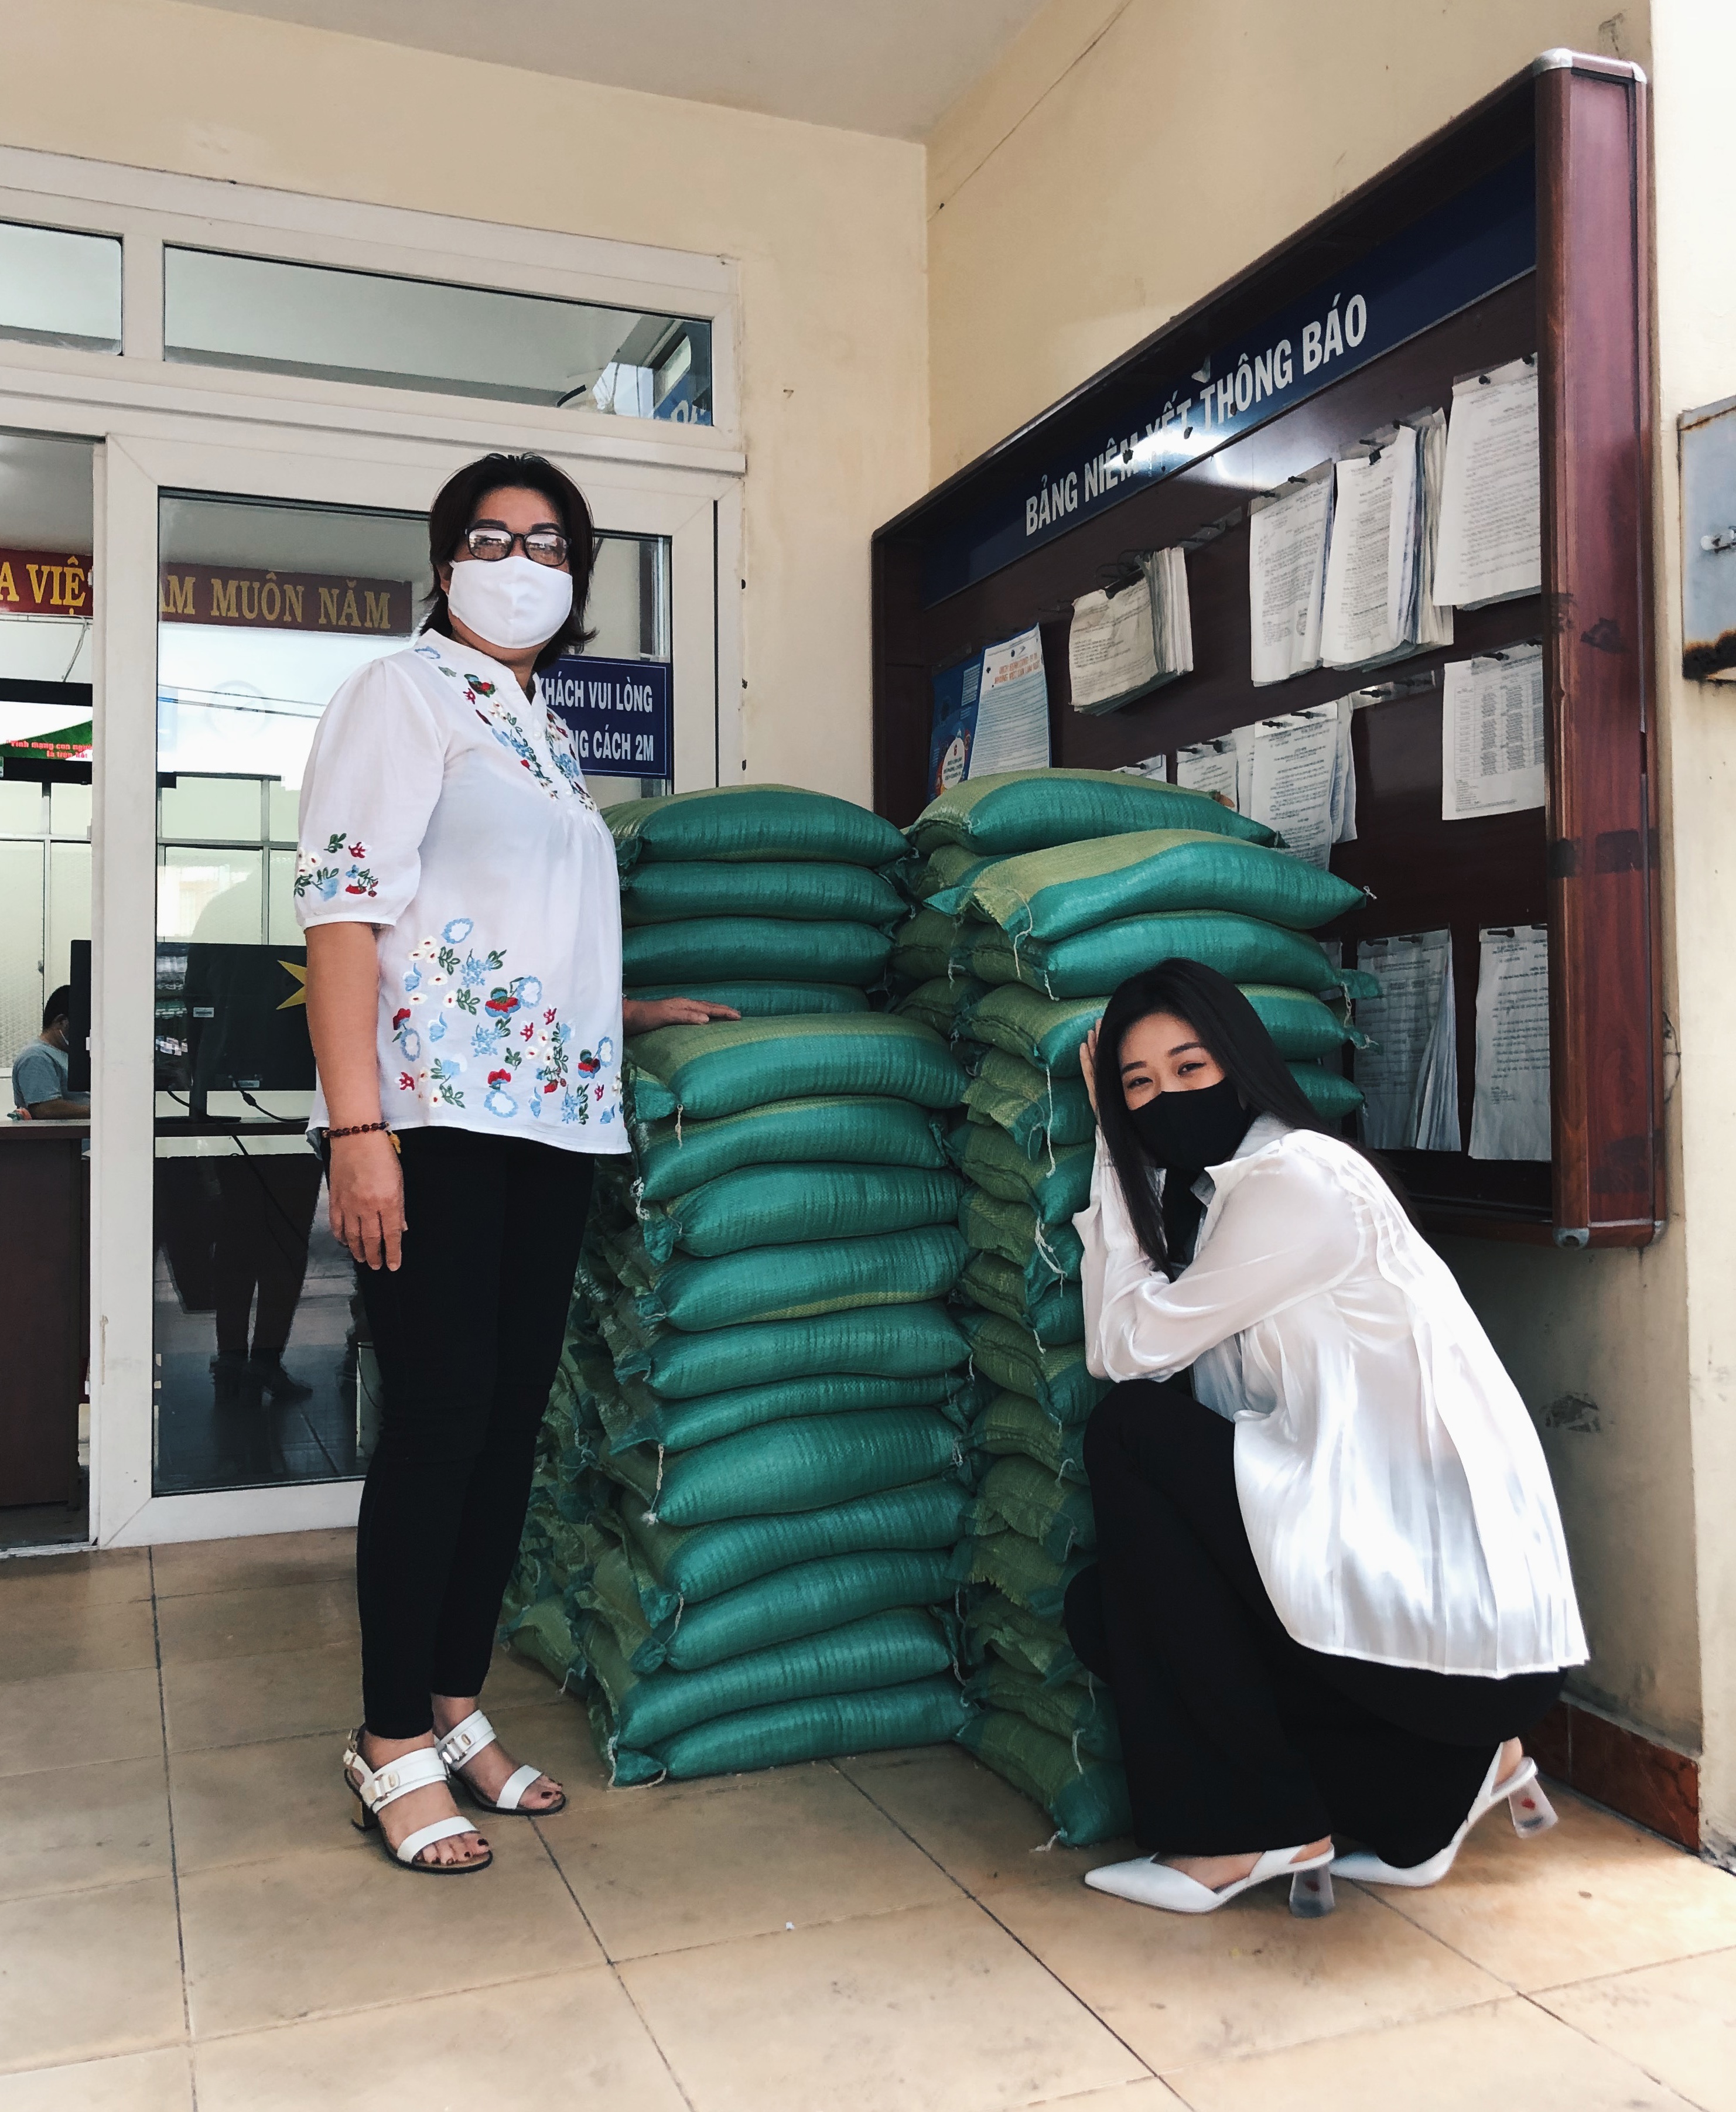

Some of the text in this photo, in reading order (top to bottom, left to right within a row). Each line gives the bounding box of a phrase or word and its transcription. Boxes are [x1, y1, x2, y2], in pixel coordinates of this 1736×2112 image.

[1026, 471, 1078, 536] BẢNG
[1084, 432, 1139, 503] NIÊM
[1200, 339, 1293, 432] THÔNG
[1302, 292, 1367, 375] BÁO
[26, 555, 87, 615] VIỆ
[210, 571, 305, 623] MUÔN
[318, 579, 391, 629] NĂM
[588, 681, 611, 710] VUI
[616, 676, 653, 713] LÒNG
[593, 724, 631, 760] CÁCH
[635, 734, 654, 761] 2M
